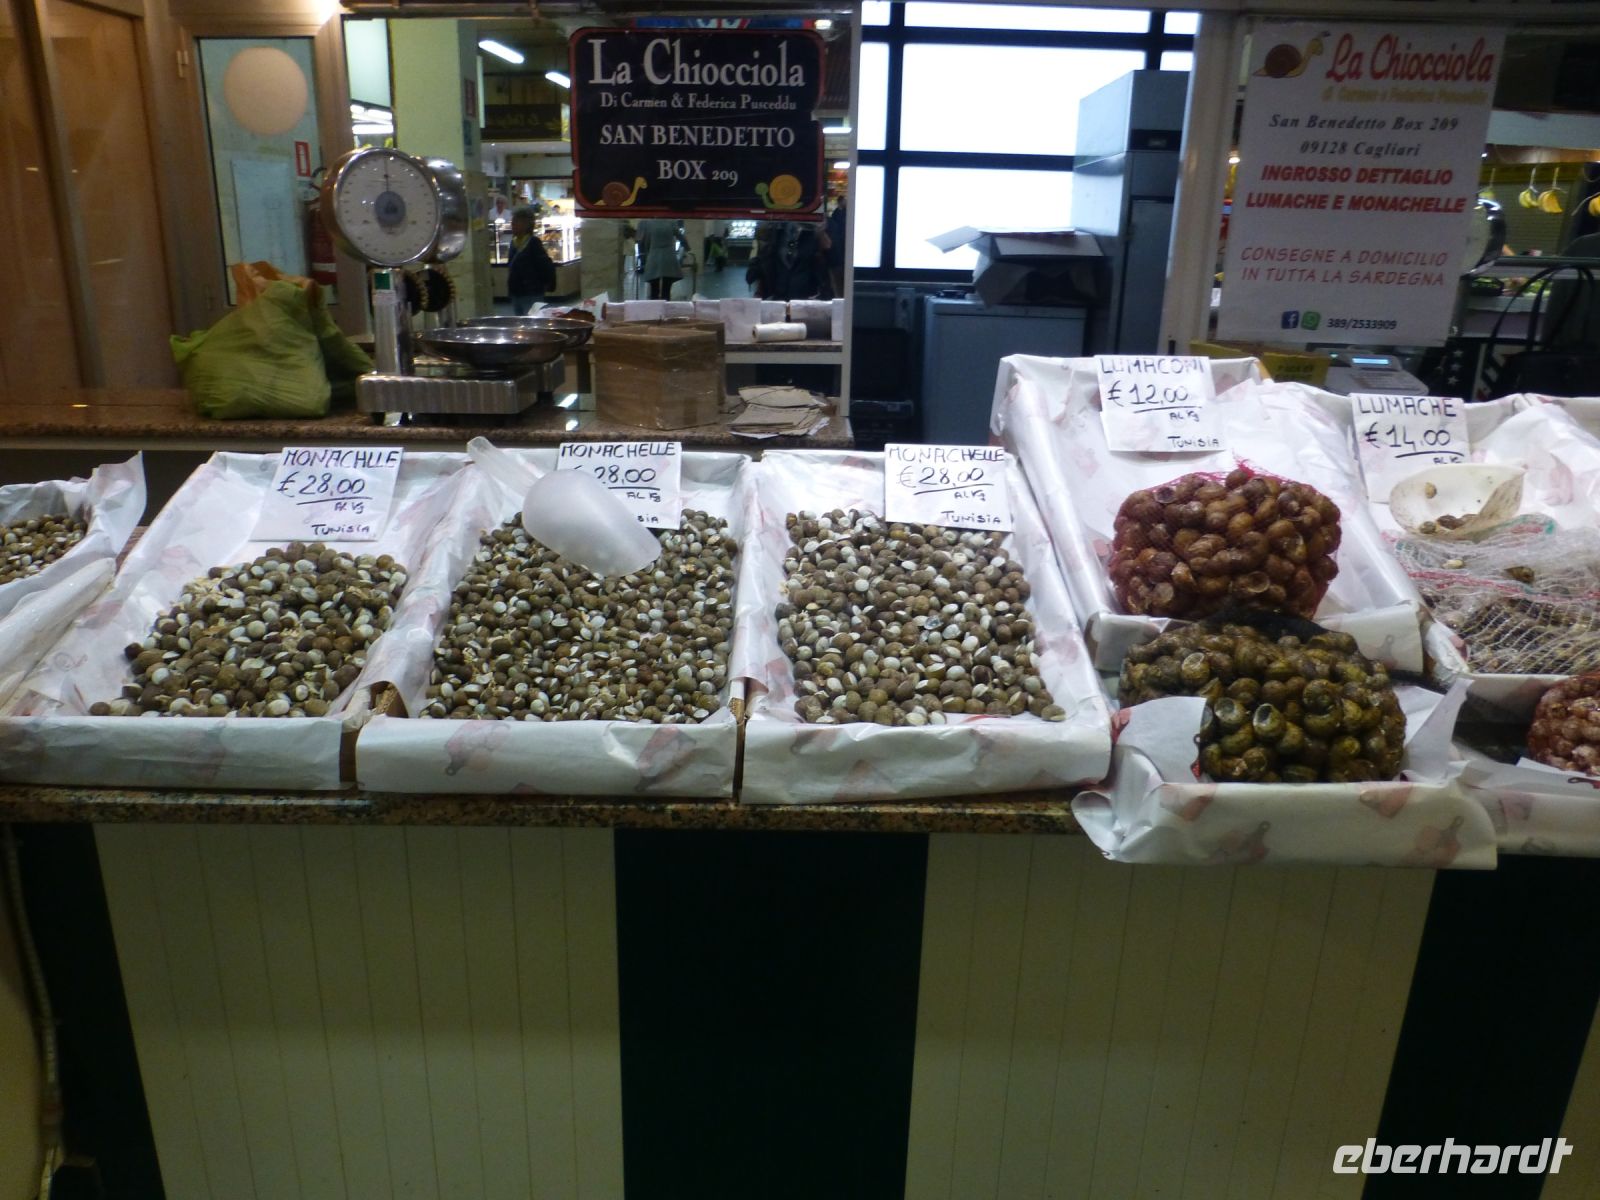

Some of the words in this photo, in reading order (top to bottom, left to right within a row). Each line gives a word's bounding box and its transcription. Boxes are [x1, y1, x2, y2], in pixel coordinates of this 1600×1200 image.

[587, 39, 633, 86] La
[643, 38, 805, 87] Chiocciola
[1325, 33, 1364, 83] La
[1370, 33, 1495, 83] Chiocciola
[600, 92, 618, 108] Di
[621, 92, 667, 108] Carmen
[671, 92, 684, 108] &
[688, 93, 736, 109] Federica
[741, 94, 797, 111] Pusceddu
[1268, 114, 1299, 128] San
[1307, 115, 1386, 130] Benedetto
[1391, 117, 1423, 130] Box
[1429, 117, 1459, 131] 209
[600, 125, 646, 145] SAN
[650, 126, 796, 147] BENEDETTO
[1300, 141, 1347, 155] 09128
[1353, 142, 1421, 158] Cagliari
[657, 160, 706, 180] BOX
[711, 170, 738, 187] 209
[1261, 165, 1351, 183] INGROSSO
[1355, 168, 1453, 185] DETTAGLIO
[1246, 192, 1328, 209] LUMACHE
[1332, 195, 1344, 210] E
[1347, 195, 1467, 213] MONACHELLE
[1240, 247, 1335, 263] CONSEGNE
[1340, 250, 1351, 263] A
[1357, 250, 1448, 267] DOMICILIO
[1241, 267, 1259, 281] IN
[1265, 269, 1316, 283] TUTTA
[1321, 270, 1343, 284] LA
[1349, 272, 1445, 287] SARDEGNA
[1327, 318, 1397, 330] 389/2533909
[1358, 396, 1457, 417] LUMACHE
[561, 442, 676, 458] MONACHELLE
[889, 446, 1005, 463] MONACHELLE
